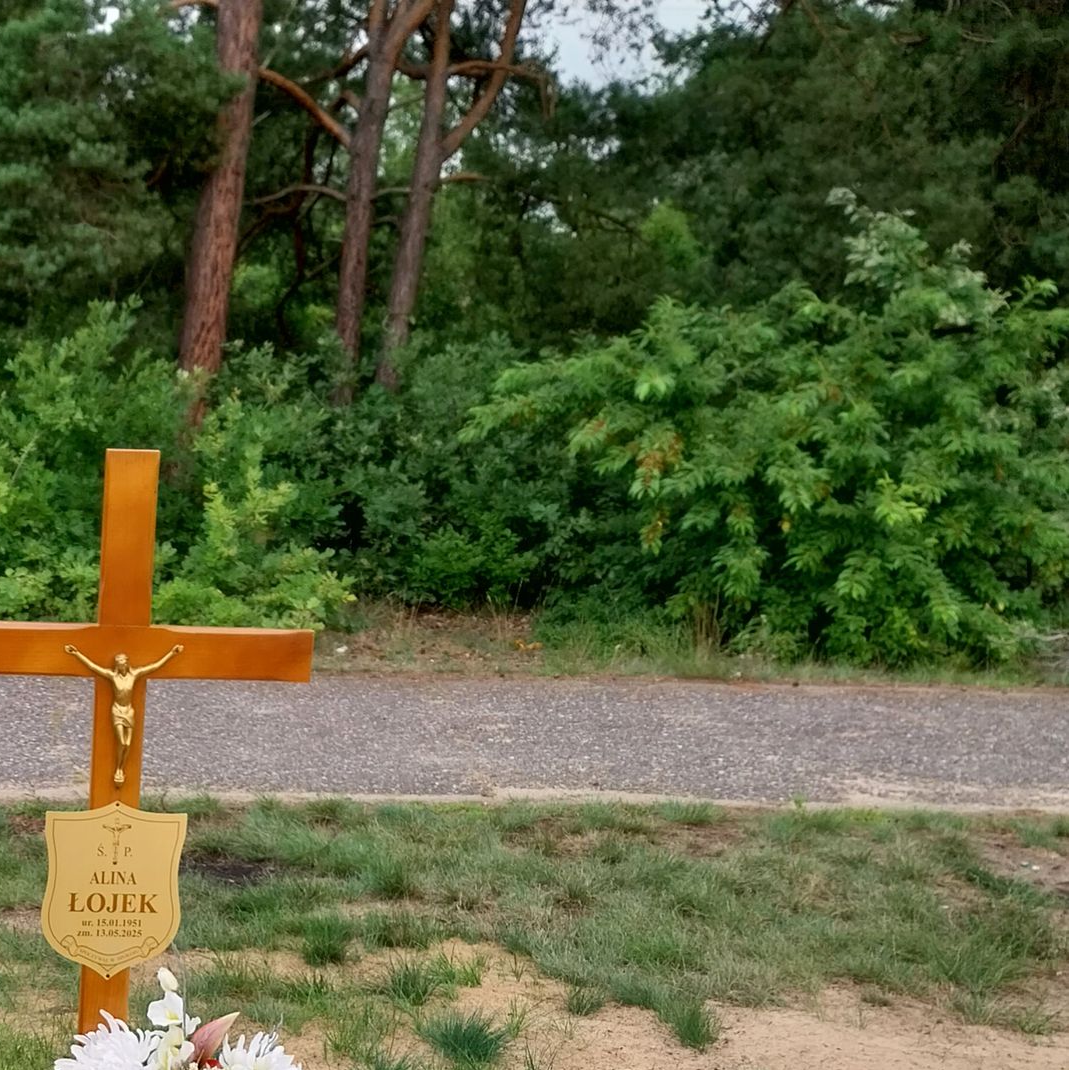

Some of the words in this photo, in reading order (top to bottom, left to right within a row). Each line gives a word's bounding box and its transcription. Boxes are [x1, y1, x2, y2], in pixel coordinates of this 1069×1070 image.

[90, 871, 137, 886] ALINA
[68, 892, 158, 914] ŁOJEK
[81, 919, 94, 927] ur.
[96, 919, 142, 927] 15.01.1951
[96, 929, 143, 938] 13.05.2025
